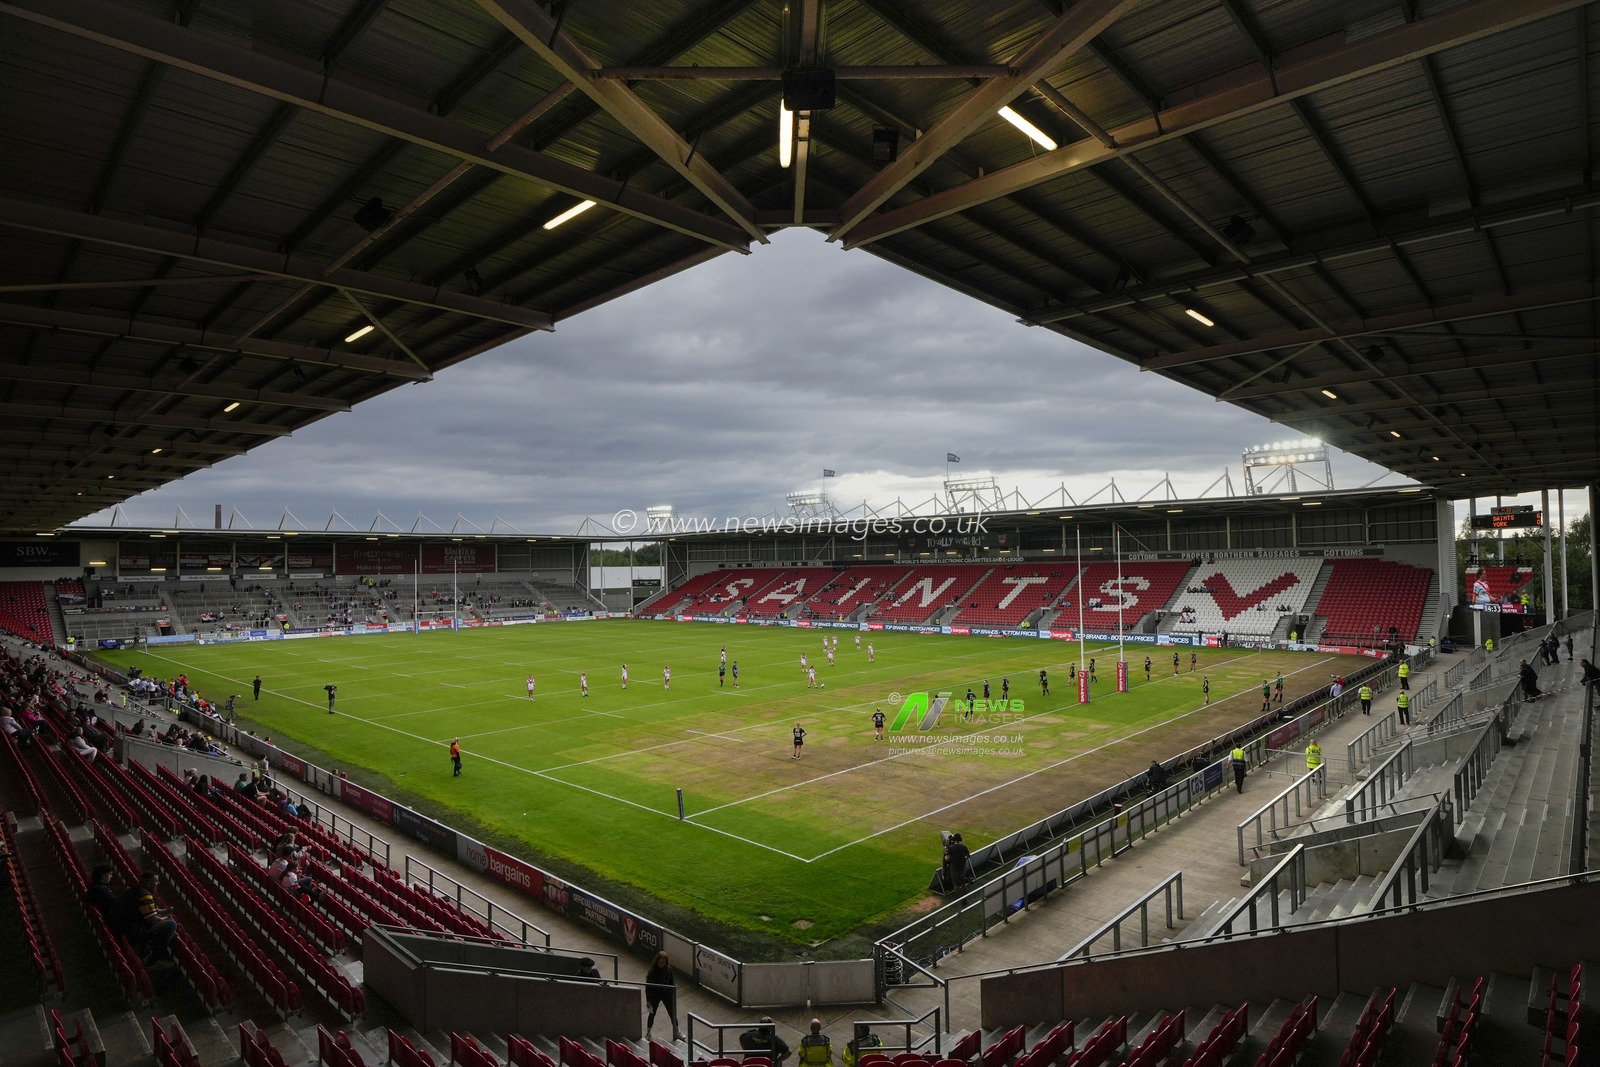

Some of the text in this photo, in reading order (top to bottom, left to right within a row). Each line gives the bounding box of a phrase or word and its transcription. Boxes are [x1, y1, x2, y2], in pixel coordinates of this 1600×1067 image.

[16, 546, 48, 556] SBW
[1181, 552, 1210, 560] PROPER
[1213, 551, 1254, 559] NORTHERN
[1324, 549, 1363, 557] COTTOMS
[709, 577, 1150, 612] SAINTS
[466, 844, 531, 888] home bargains
[572, 893, 620, 922] OFFICIAL HYDRATION
[585, 908, 607, 926] PARTNER
[702, 949, 731, 969] SEATS SEATS
